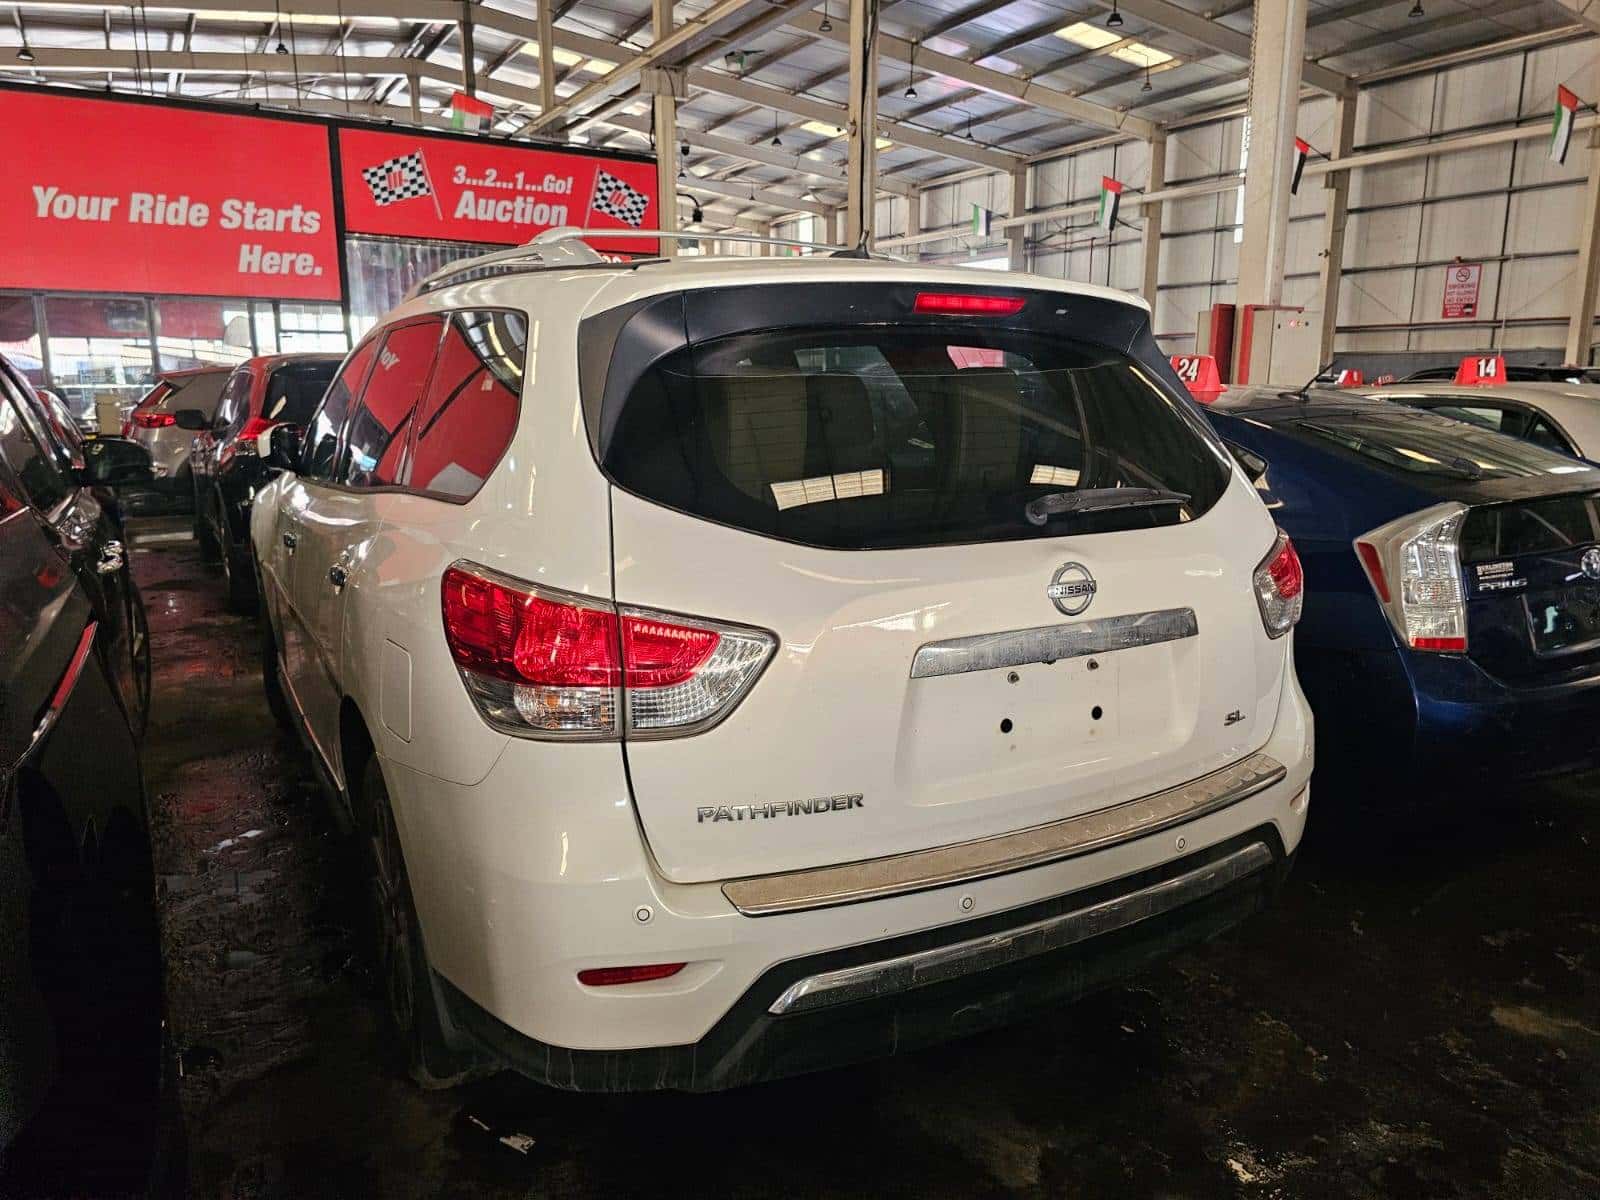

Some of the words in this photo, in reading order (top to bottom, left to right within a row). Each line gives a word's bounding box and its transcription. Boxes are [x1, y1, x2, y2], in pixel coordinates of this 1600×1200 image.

[32, 185, 118, 221] Your
[128, 192, 209, 227] Ride
[219, 198, 321, 234] Starts
[454, 190, 568, 227] Auction
[238, 243, 323, 277] Here.
[1178, 358, 1199, 382] 24
[1478, 358, 1496, 377] 14
[1055, 583, 1094, 595] NISSAN
[1479, 577, 1528, 591] PRIUS
[1224, 709, 1246, 727] SL
[697, 793, 864, 823] PATHFINDER
